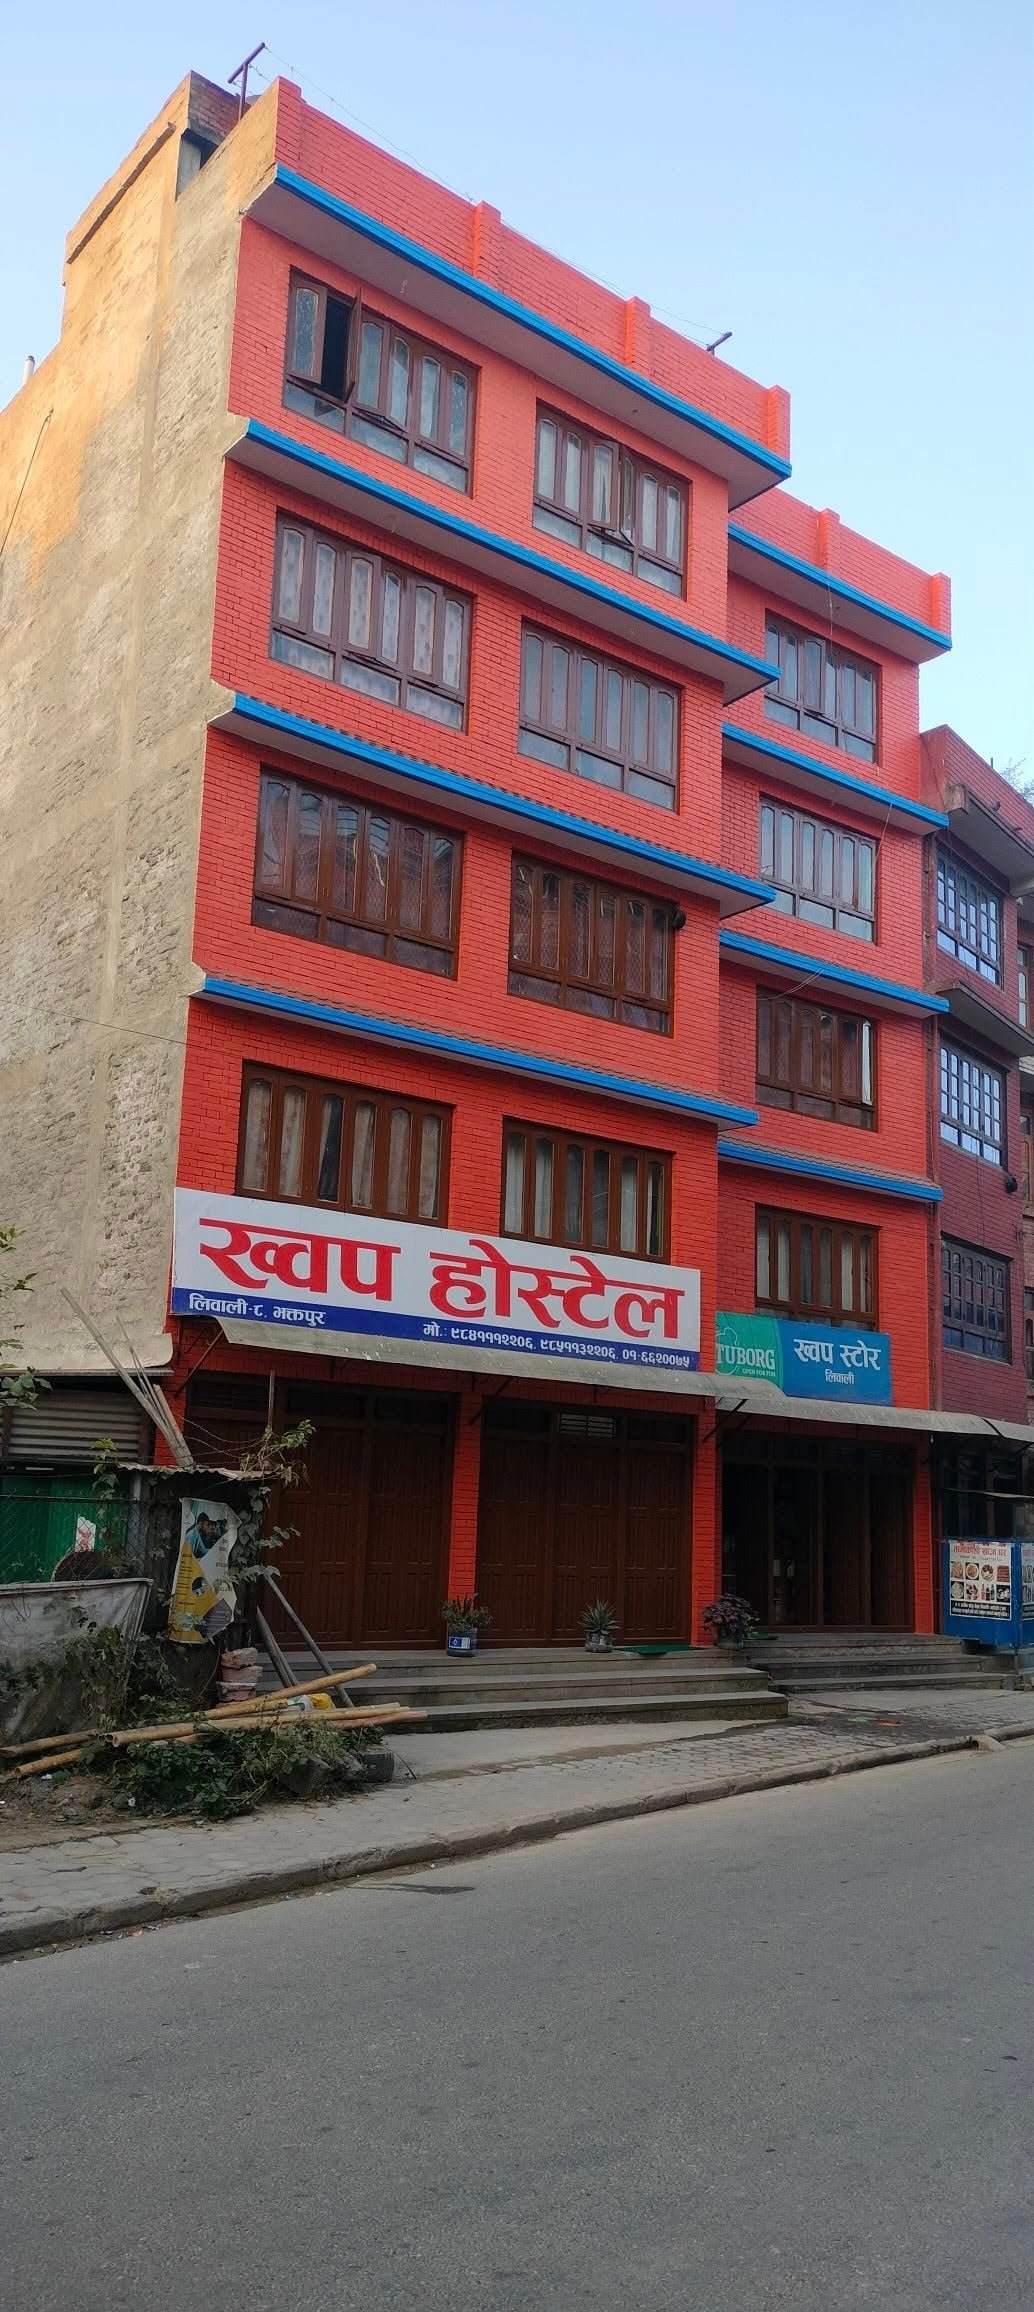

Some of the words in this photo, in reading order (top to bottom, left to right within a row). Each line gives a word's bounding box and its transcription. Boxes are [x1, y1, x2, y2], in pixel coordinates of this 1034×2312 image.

[199, 1217, 402, 1302] ख्वप
[429, 1238, 686, 1340] होस्टेल
[273, 1306, 327, 1326] भक्तपुर
[716, 1343, 776, 1370] TUBORG
[793, 1338, 834, 1364] ख्वप
[839, 1339, 882, 1371] स्टोर
[824, 1368, 855, 1385] लिवाली
